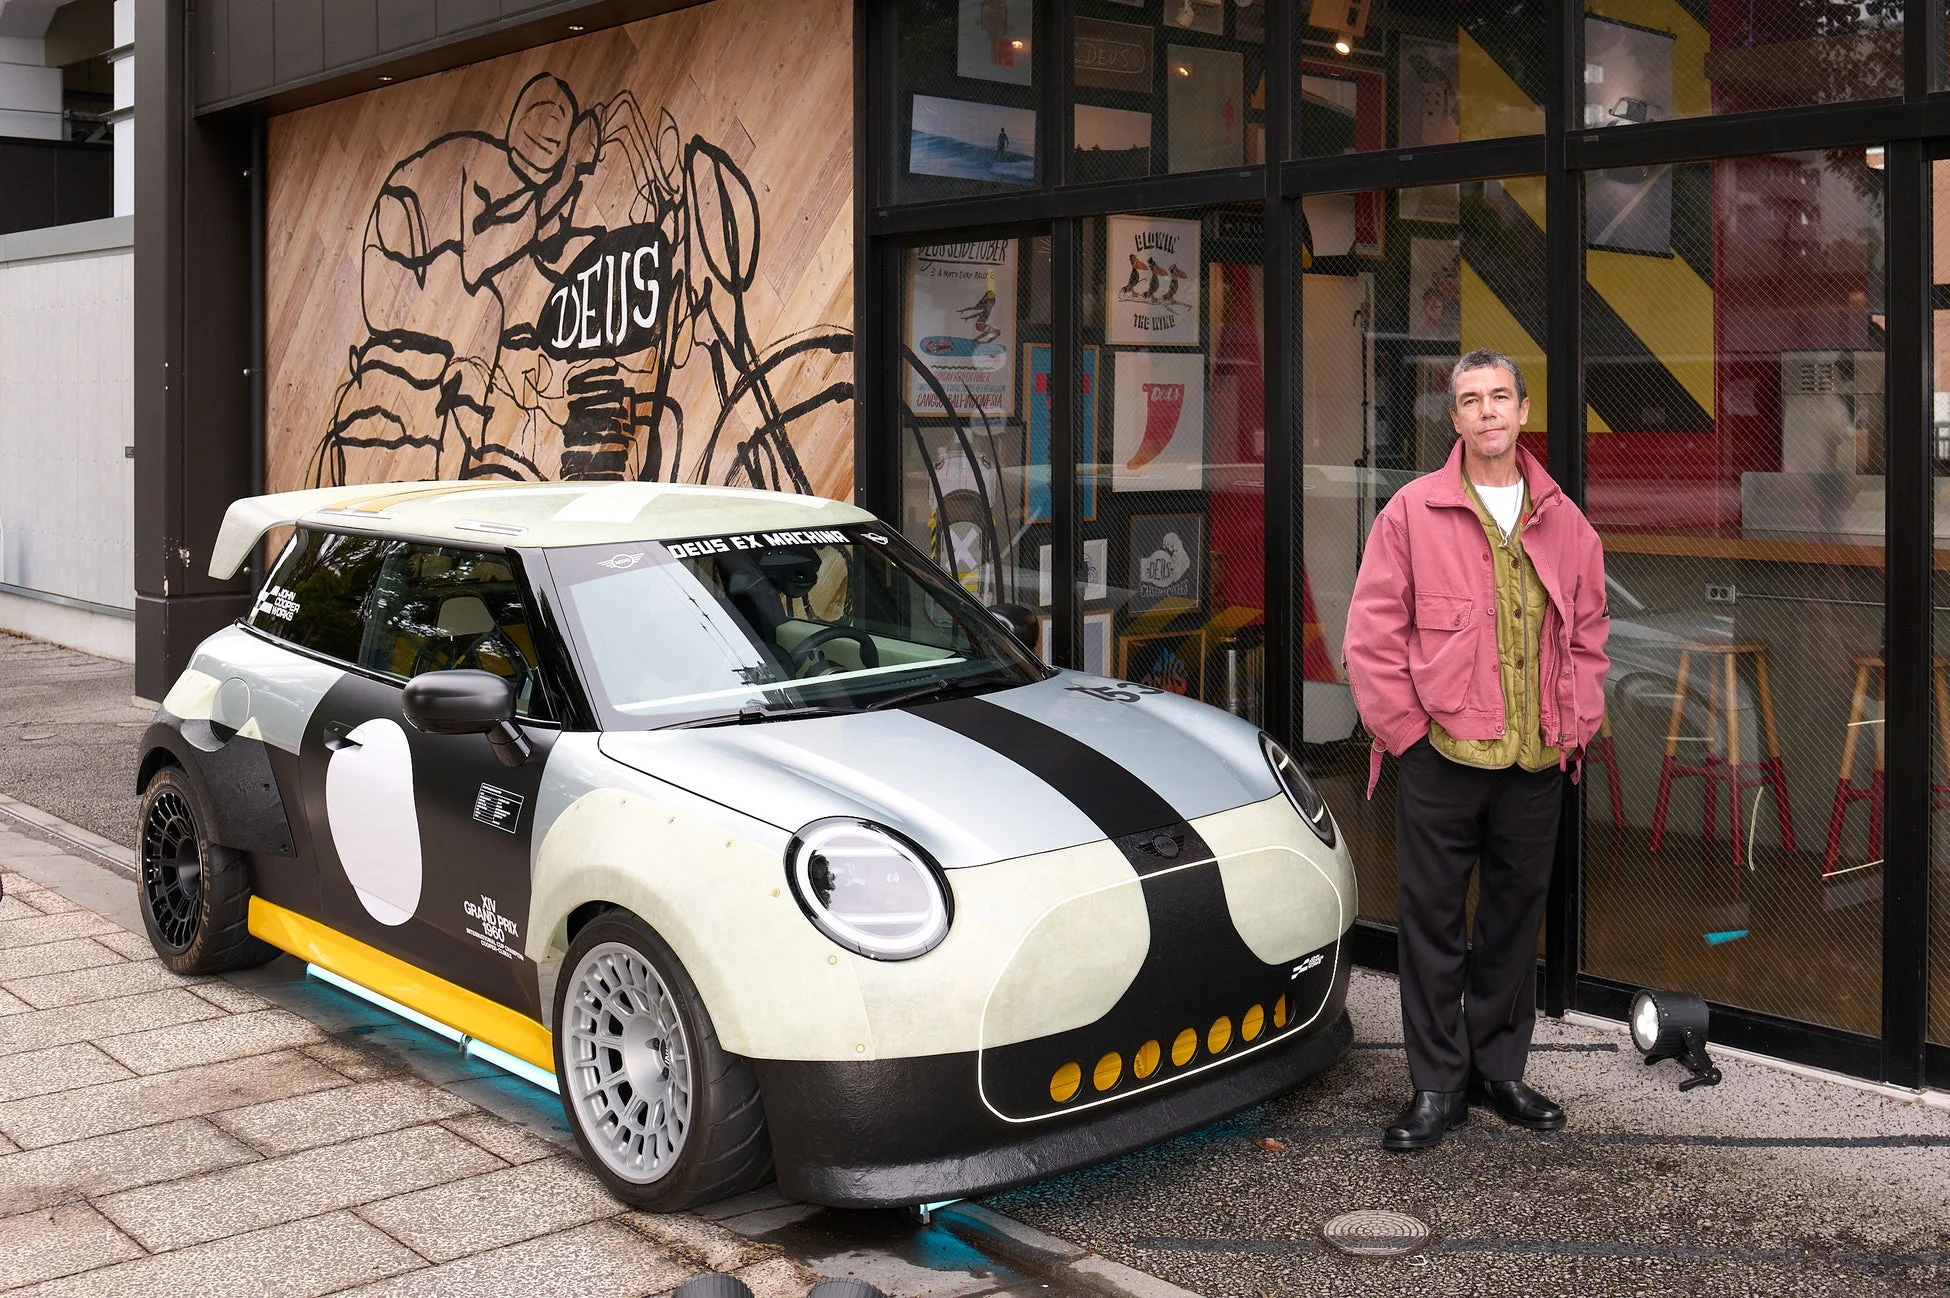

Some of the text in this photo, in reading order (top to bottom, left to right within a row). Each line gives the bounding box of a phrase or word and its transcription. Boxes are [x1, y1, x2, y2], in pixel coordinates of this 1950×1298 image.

[551, 241, 660, 349] DEUS
[667, 530, 851, 559] DEUS EX MACHINA
[1148, 558, 1171, 581] DEUS
[274, 596, 301, 614] COOPER
[278, 588, 297, 602] JOHN
[271, 605, 295, 622] WORKS
[480, 894, 496, 913] XIV
[464, 900, 519, 938] GRAND PRIX
[482, 921, 505, 943] 1960
